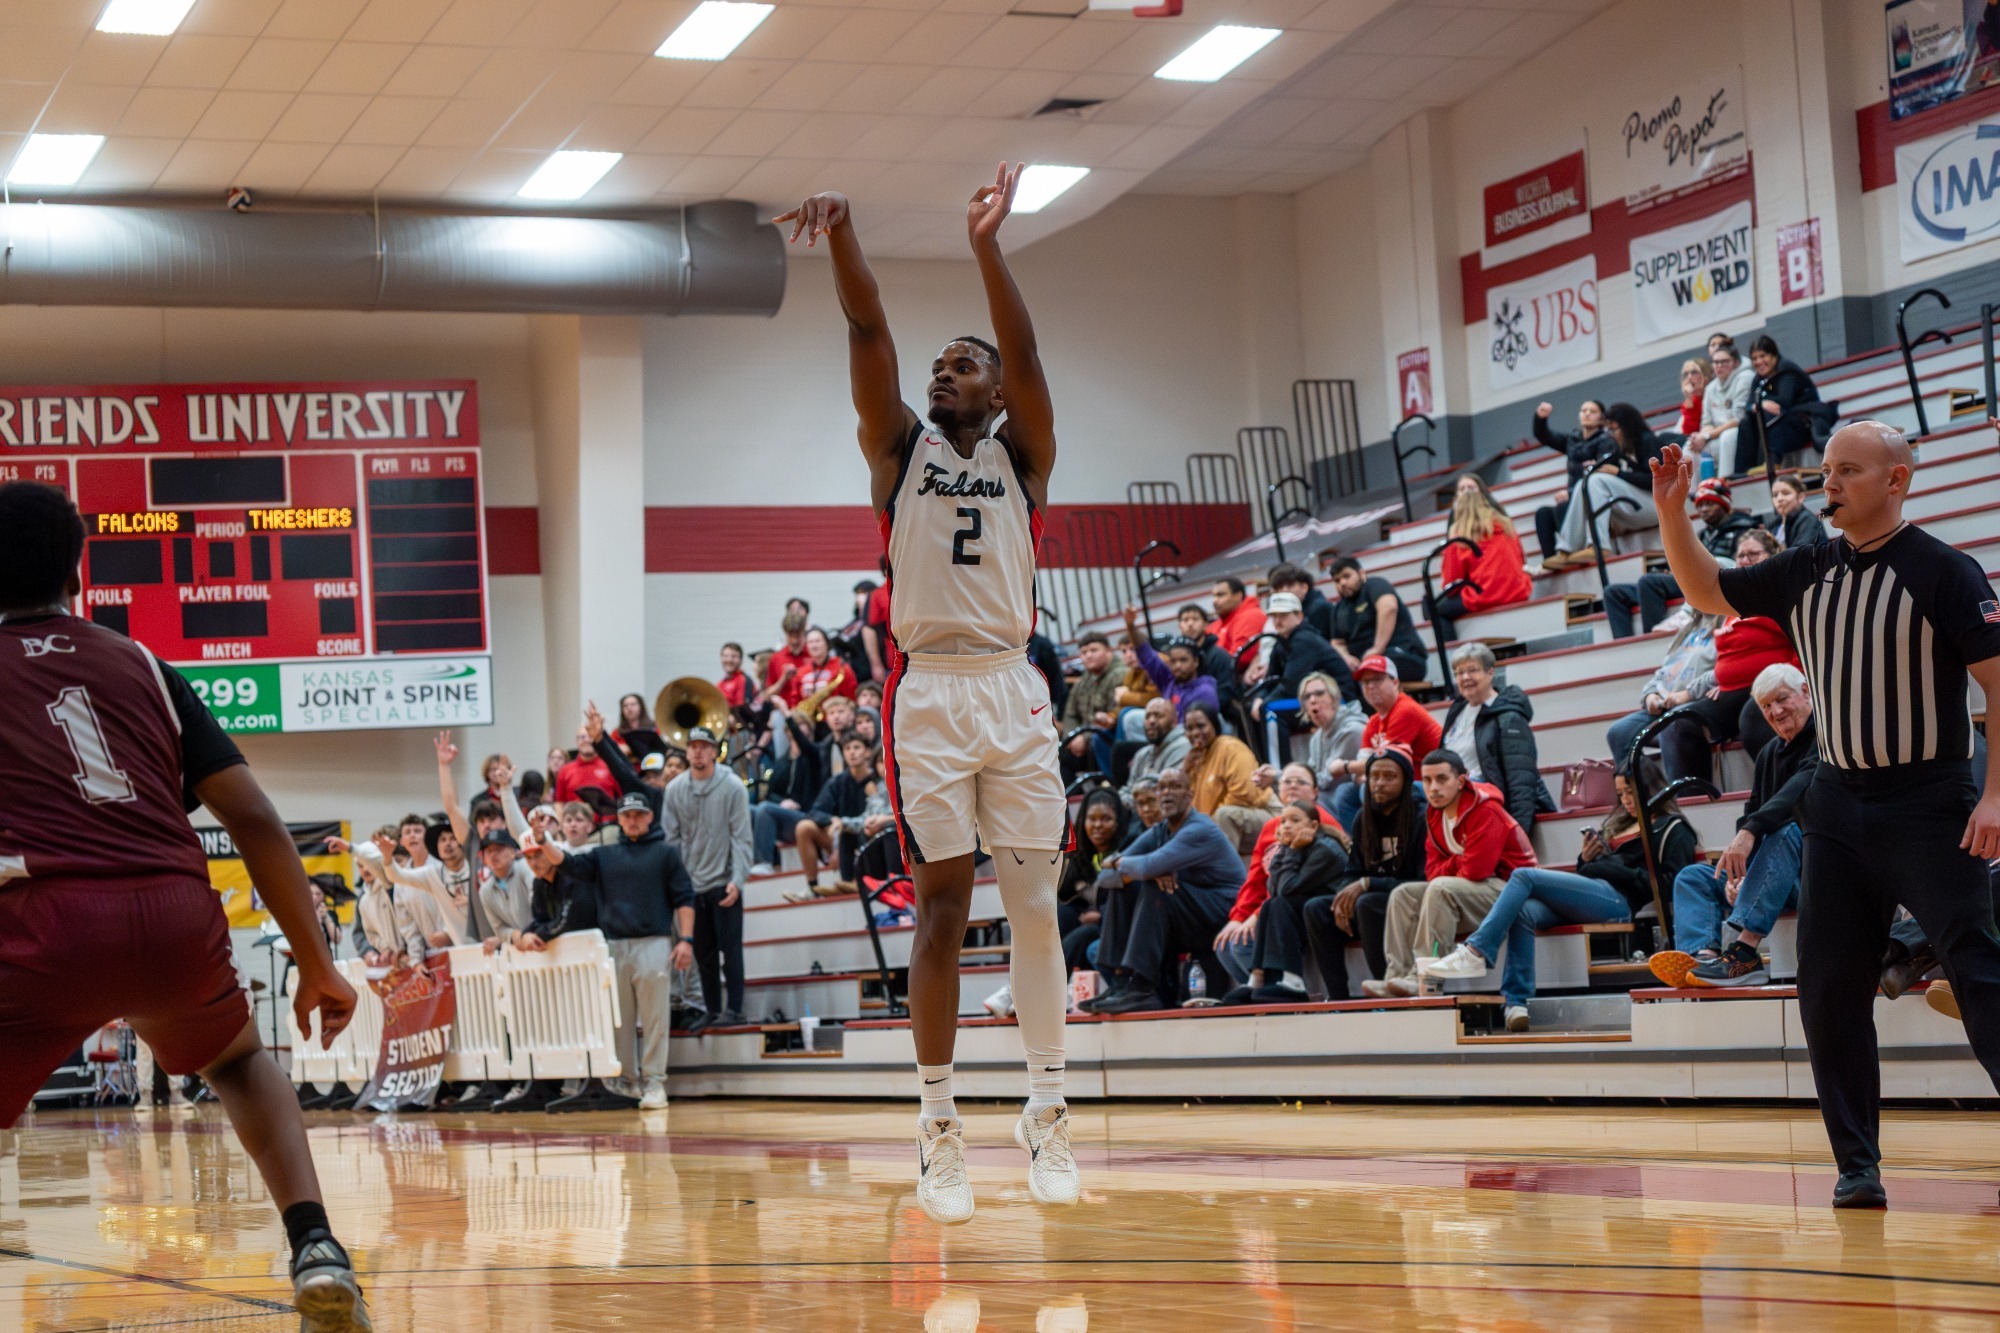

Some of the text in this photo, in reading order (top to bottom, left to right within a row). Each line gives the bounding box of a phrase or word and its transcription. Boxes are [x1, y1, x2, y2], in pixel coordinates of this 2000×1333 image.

[1622, 96, 1682, 159] Promo
[1664, 88, 1726, 167] Depot
[1634, 225, 1749, 287] SUPPLEMENT
[1787, 247, 1809, 292] B
[1530, 279, 1598, 349] UBS
[1405, 371, 1424, 409] A
[186, 390, 466, 447] UNIVERSITY
[35, 465, 56, 480] PTS
[411, 458, 430, 473] FLS
[445, 457, 466, 472] PTS
[98, 512, 179, 533] FALCONS
[249, 508, 352, 529] THRESHERS
[196, 522, 245, 538] PERIOD
[952, 507, 981, 565] 2
[87, 588, 133, 605] FOULS
[180, 584, 270, 602] PLAYER FOUL
[314, 582, 358, 598] FOULS
[202, 643, 251, 659] MATCH
[317, 639, 361, 655] SCORE
[302, 669, 394, 687] KANSAS
[298, 686, 376, 708] JOINT
[404, 683, 478, 703] SPINE
[303, 703, 481, 724] SPECIALISTS
[45, 685, 137, 804] 1
[387, 1025, 451, 1066] STUDENT
